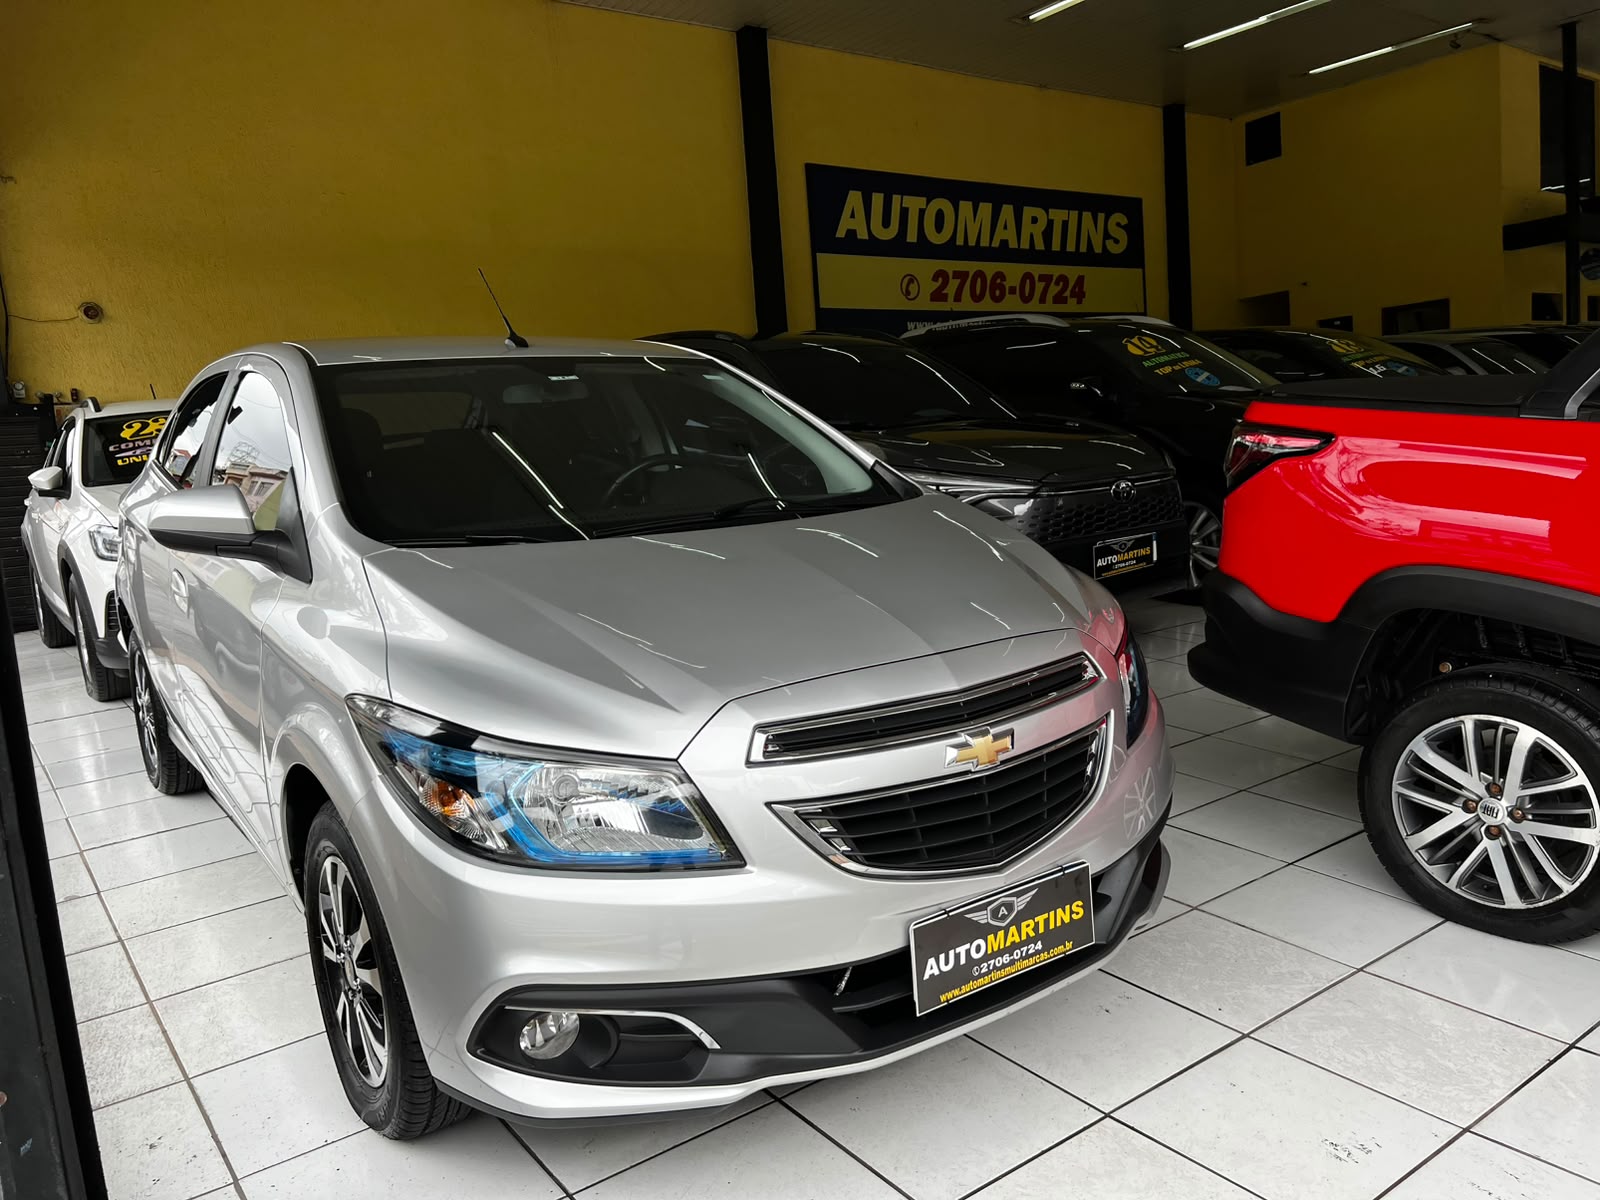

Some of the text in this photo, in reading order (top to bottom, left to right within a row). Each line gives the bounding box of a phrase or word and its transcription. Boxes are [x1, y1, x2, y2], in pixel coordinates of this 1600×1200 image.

[835, 189, 1129, 255] AUTOMARTINS
[929, 268, 1087, 306] 2706-0724
[1154, 365, 1172, 376] TOP
[108, 439, 156, 452] COM
[1096, 546, 1151, 568] AUTOMARTINS
[923, 900, 1085, 981] AUTOMARTINS
[980, 940, 1043, 975] 2706-0724
[940, 940, 1074, 1003] www.automartinsmultimarcas.com.br
